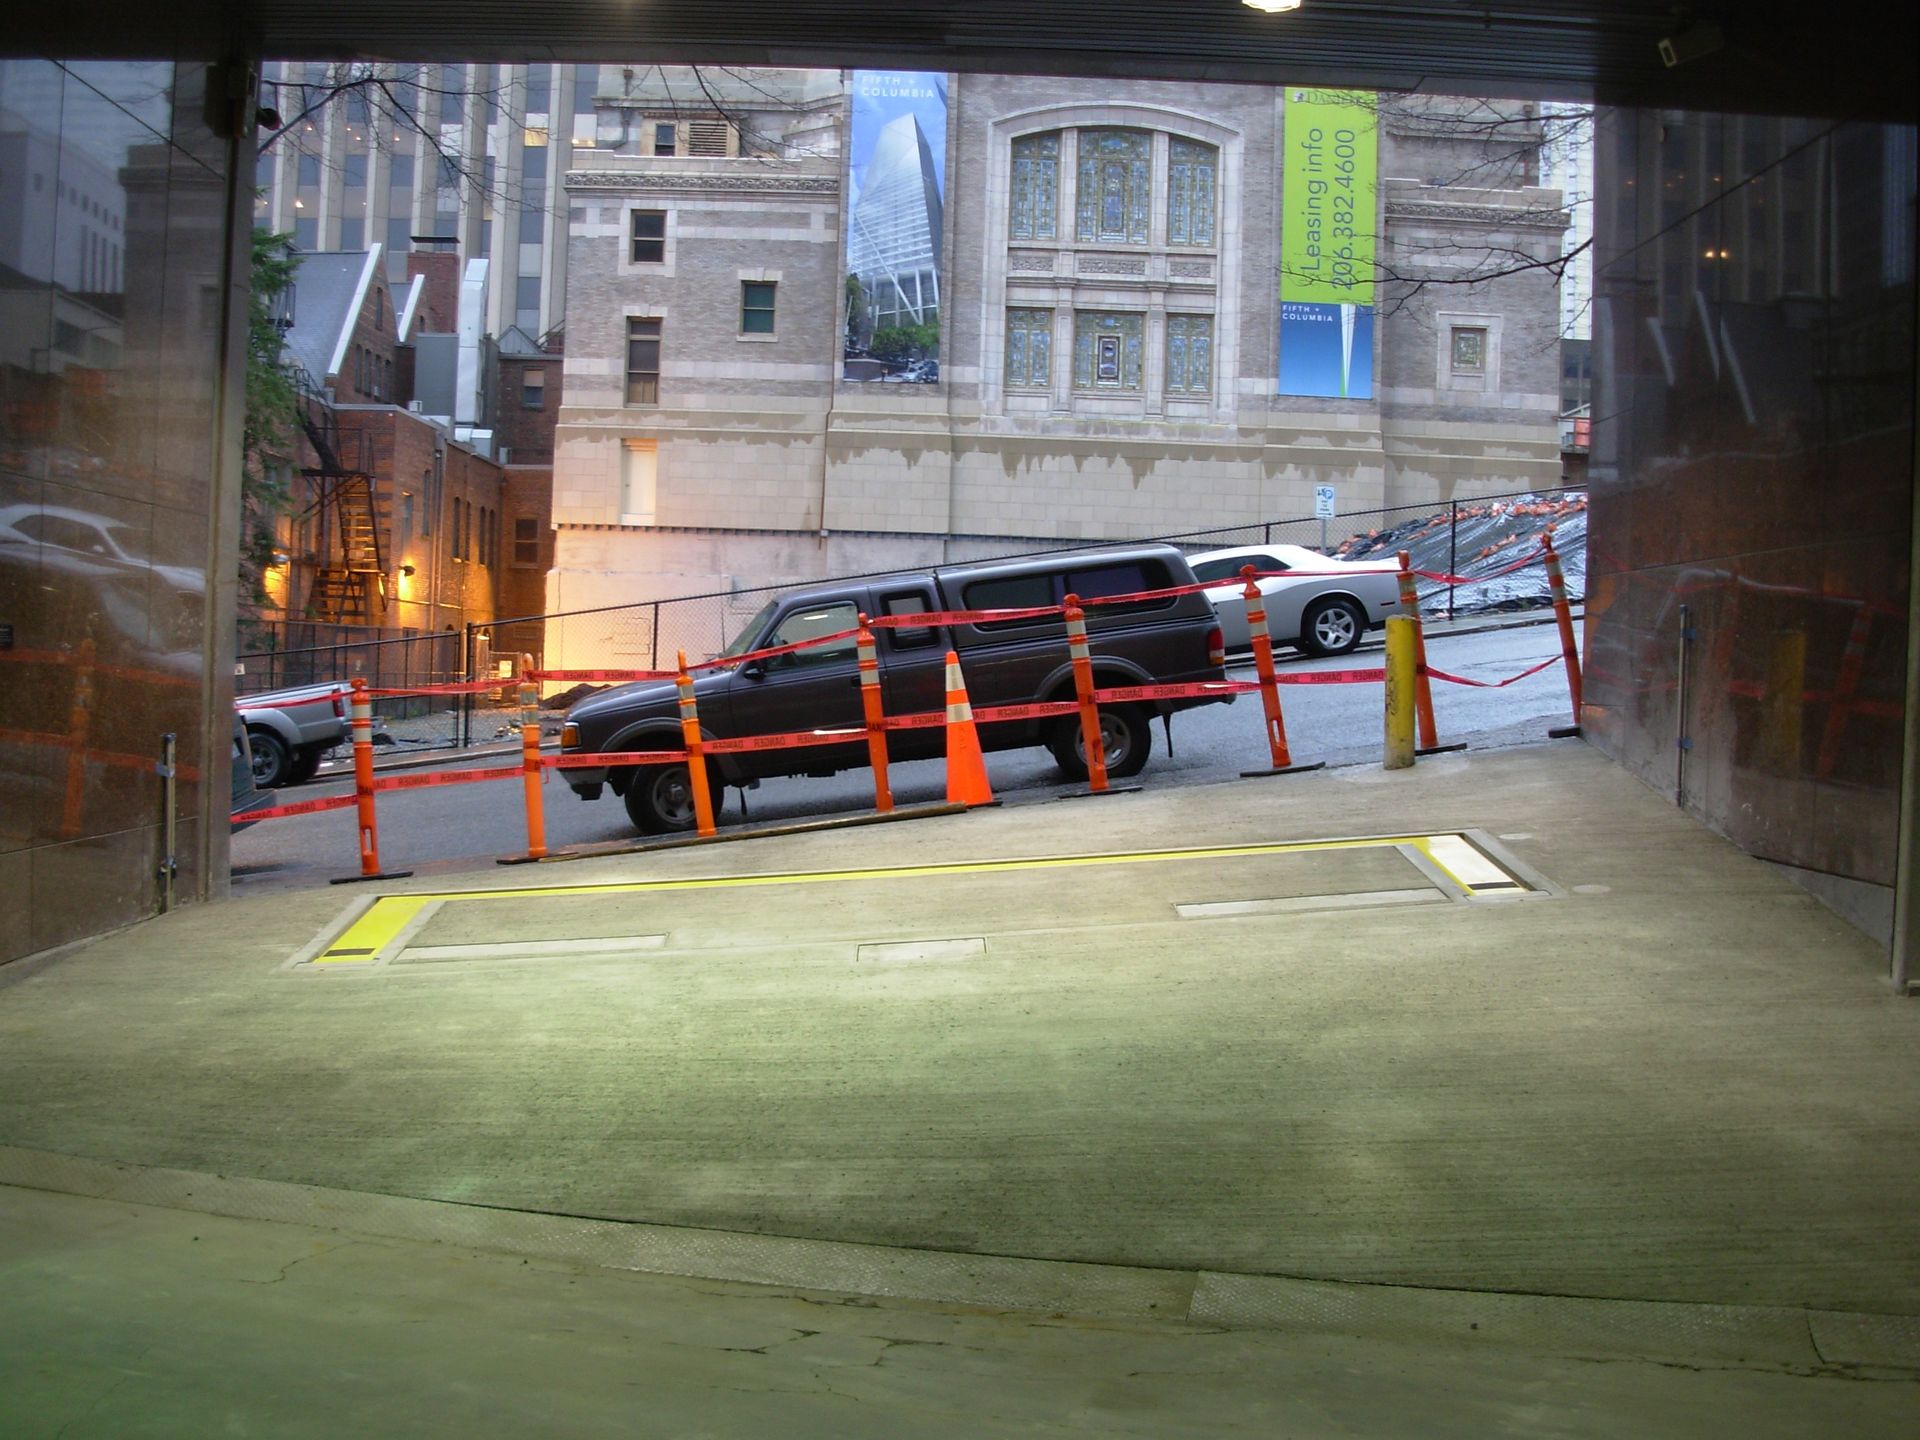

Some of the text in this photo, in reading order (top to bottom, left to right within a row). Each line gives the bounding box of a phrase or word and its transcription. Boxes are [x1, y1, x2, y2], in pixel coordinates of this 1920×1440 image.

[862, 76, 900, 85] FIFTH
[862, 87, 935, 98] COLUMBIA
[1300, 128, 1328, 271] Leasing info
[1332, 129, 1356, 291] 206.382.4600
[1282, 304, 1311, 312] FIFTH
[1282, 313, 1333, 322] COLUMBIA
